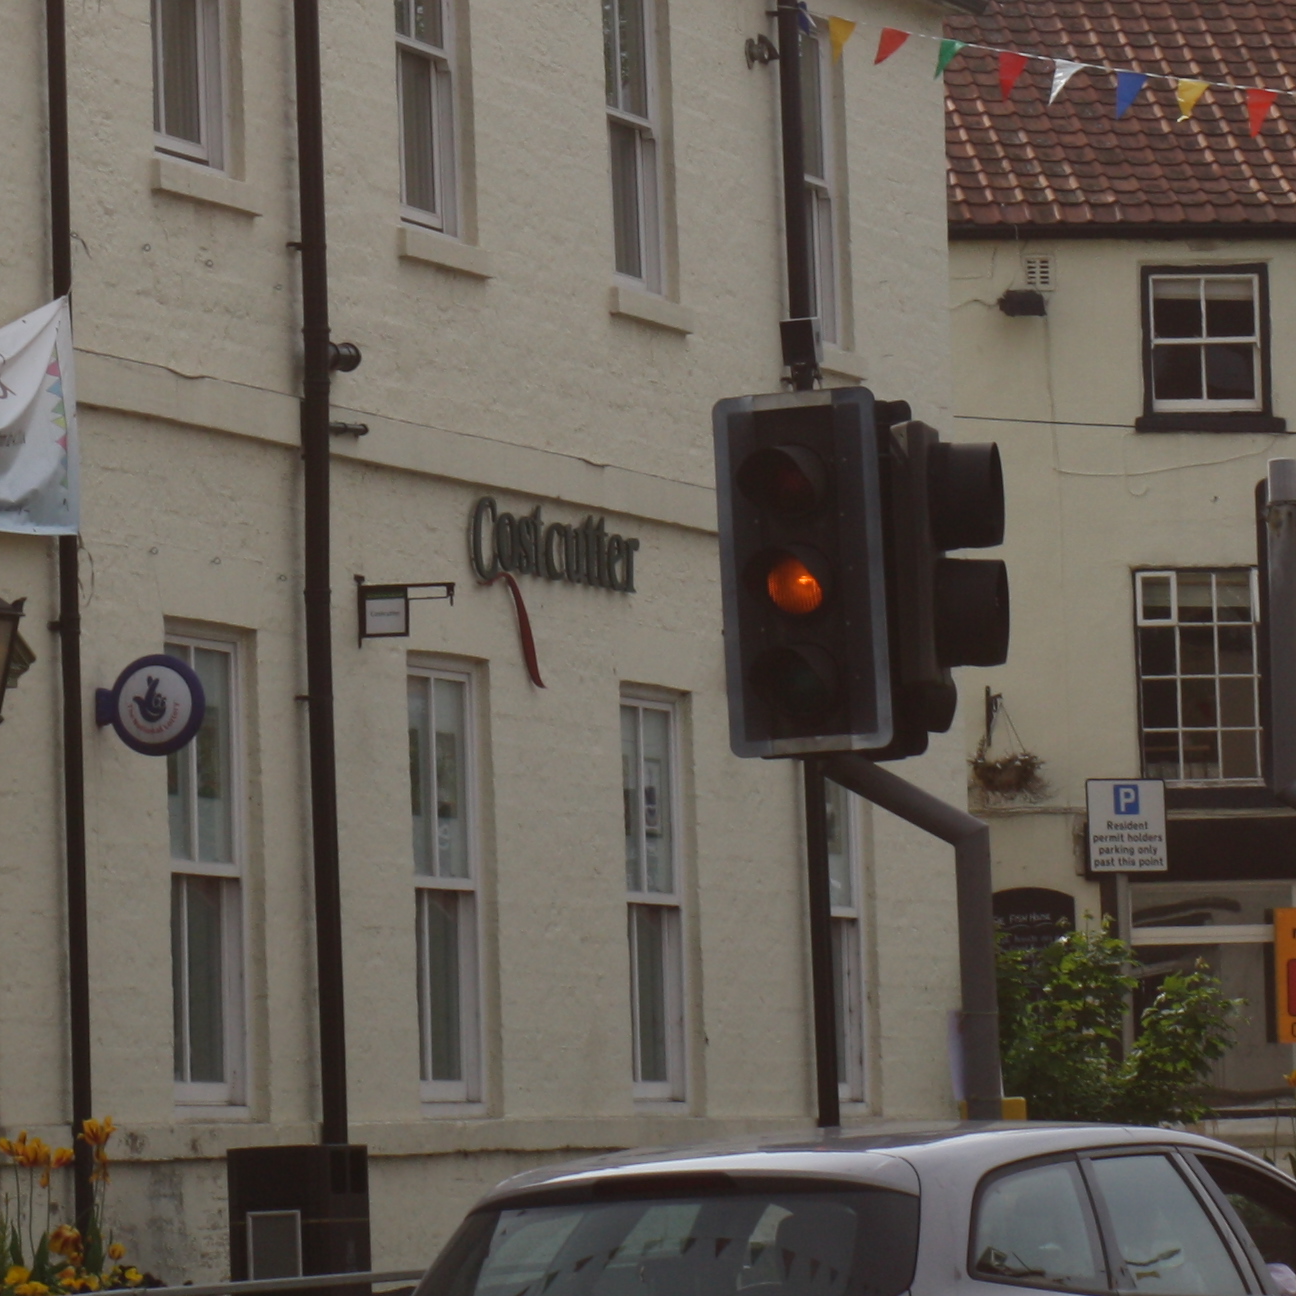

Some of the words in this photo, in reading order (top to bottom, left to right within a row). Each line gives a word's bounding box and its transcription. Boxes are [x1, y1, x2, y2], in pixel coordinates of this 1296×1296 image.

[470, 495, 640, 594] Costcutter
[1119, 787, 1135, 812] P
[1107, 820, 1148, 830] Resident
[1093, 833, 1124, 843] permit
[1127, 833, 1163, 842] holders
[1098, 845, 1135, 856] parking
[1138, 845, 1158, 856] only
[1094, 857, 1115, 868] past
[1118, 857, 1136, 866] this
[1139, 857, 1164, 868] point
